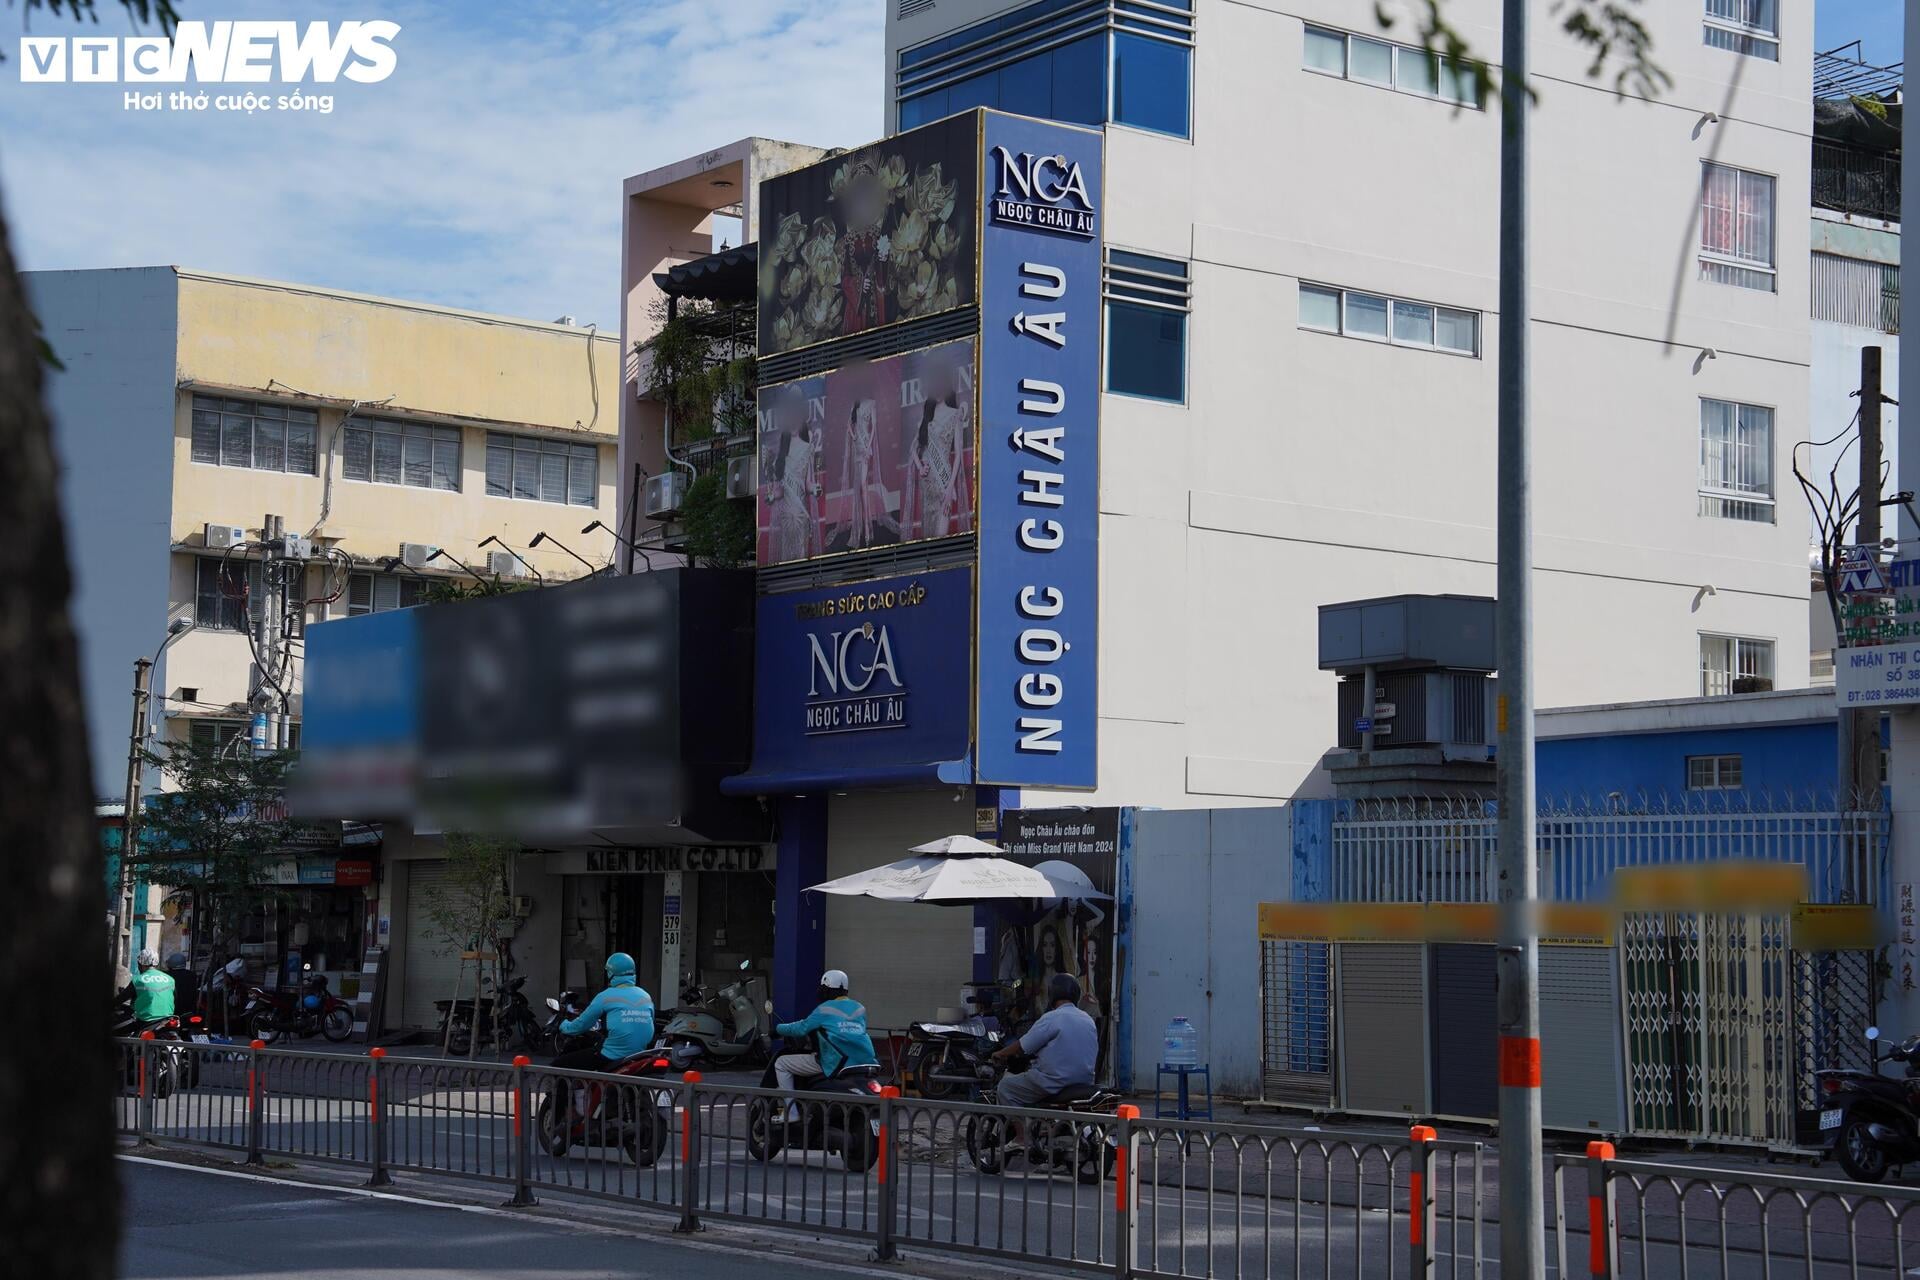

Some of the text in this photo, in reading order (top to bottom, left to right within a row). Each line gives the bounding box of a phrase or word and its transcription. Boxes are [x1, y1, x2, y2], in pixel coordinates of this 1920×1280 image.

[998, 146, 1094, 209] NCA
[998, 201, 1094, 231] NGỌC CHÂU ÂU
[1014, 262, 1071, 752] NGỌC CHÂU ÂU
[838, 592, 865, 615] SỨC
[868, 591, 895, 611] CAO
[899, 581, 926, 607] CẤP
[807, 624, 903, 696] NCA
[1850, 651, 1882, 669] NHẬN
[1888, 651, 1906, 665] THI
[1886, 666, 1903, 682] SỐ
[806, 697, 903, 730] NGỌC CHÂU ÂU
[1020, 823, 1095, 839] Ngọc Châu Âu chào đón
[1013, 842, 1026, 854] sinh
[1027, 842, 1041, 854] Miss
[1043, 842, 1061, 854] Grand
[1063, 842, 1076, 855] Việt
[1078, 841, 1093, 853] Nam
[1095, 841, 1113, 853] 2024
[664, 916, 680, 929] 379
[664, 932, 680, 945] 381
[141, 974, 169, 984] Grab
